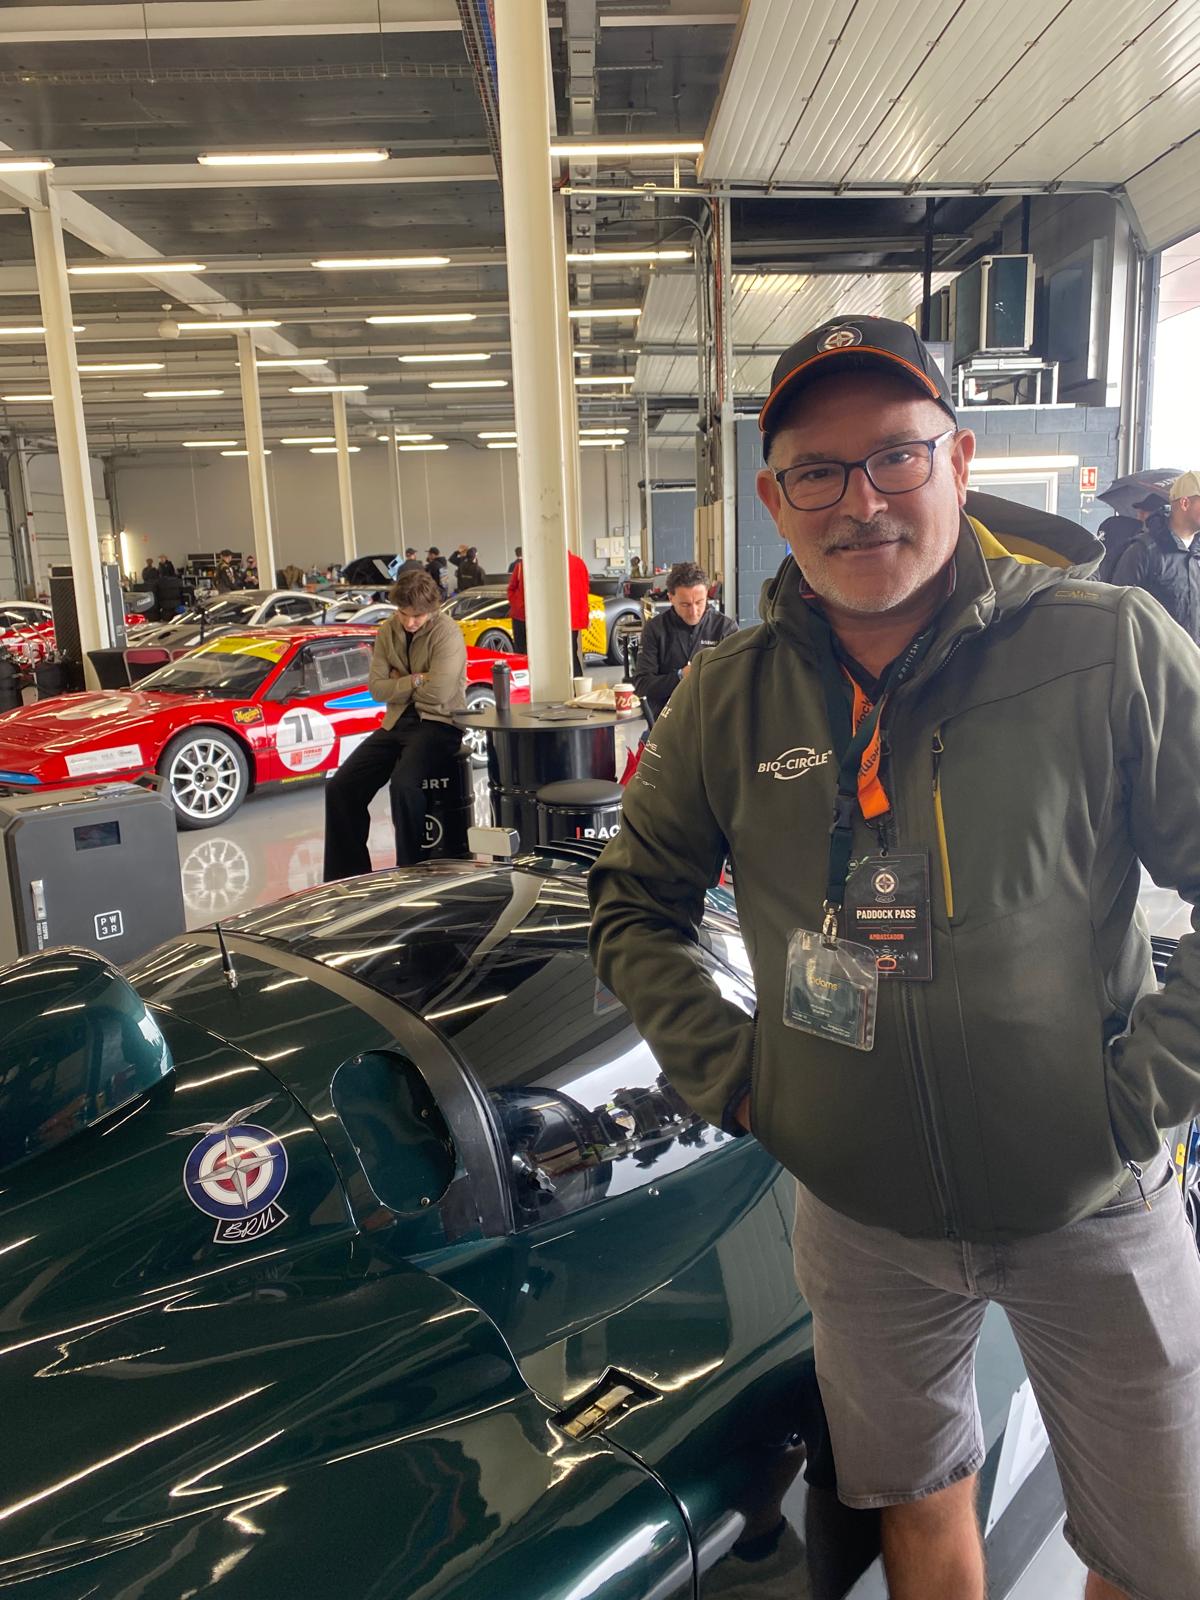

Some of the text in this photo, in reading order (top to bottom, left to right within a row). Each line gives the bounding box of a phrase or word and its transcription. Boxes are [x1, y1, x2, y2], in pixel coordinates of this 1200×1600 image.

[284, 713, 314, 744] 71
[856, 909, 917, 920] PADDOCK PASS
[222, 1207, 276, 1239] BRM
